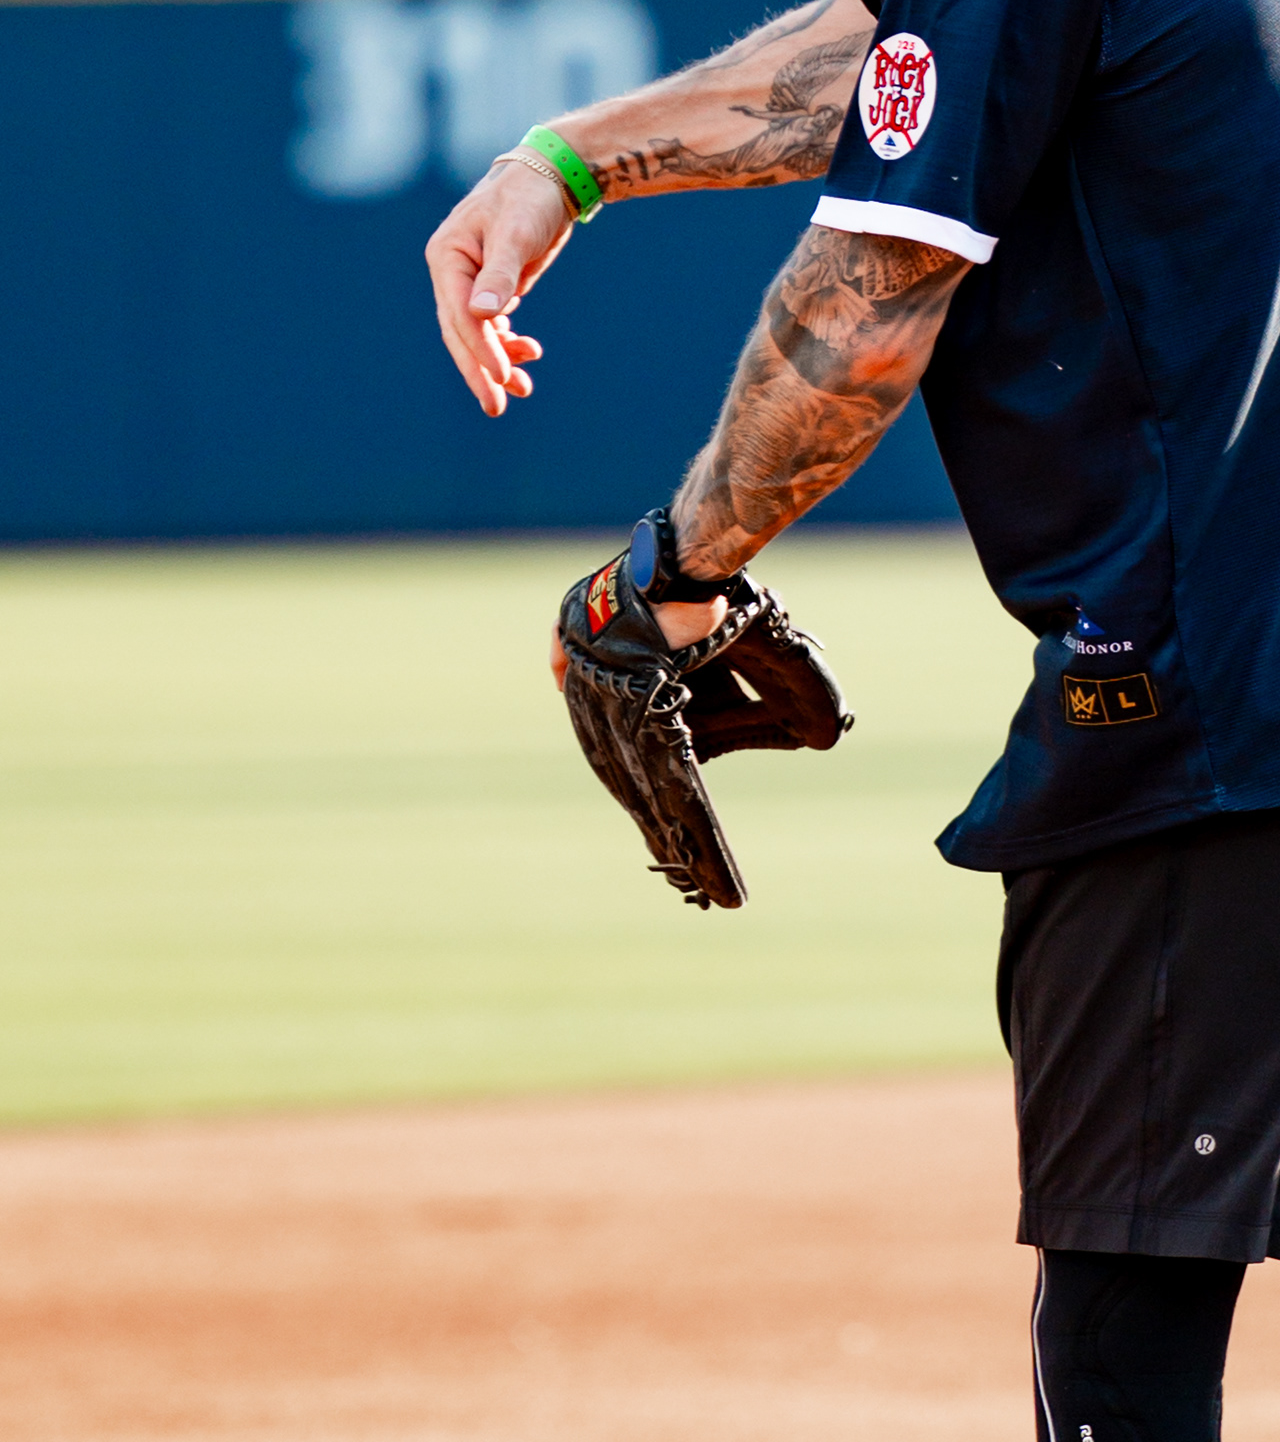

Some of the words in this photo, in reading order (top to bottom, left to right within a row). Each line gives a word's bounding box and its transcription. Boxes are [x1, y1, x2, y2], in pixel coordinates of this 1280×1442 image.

[607, 555, 624, 614] EASTO
[1076, 640, 1133, 654] HONOR
[1118, 692, 1137, 709] L
